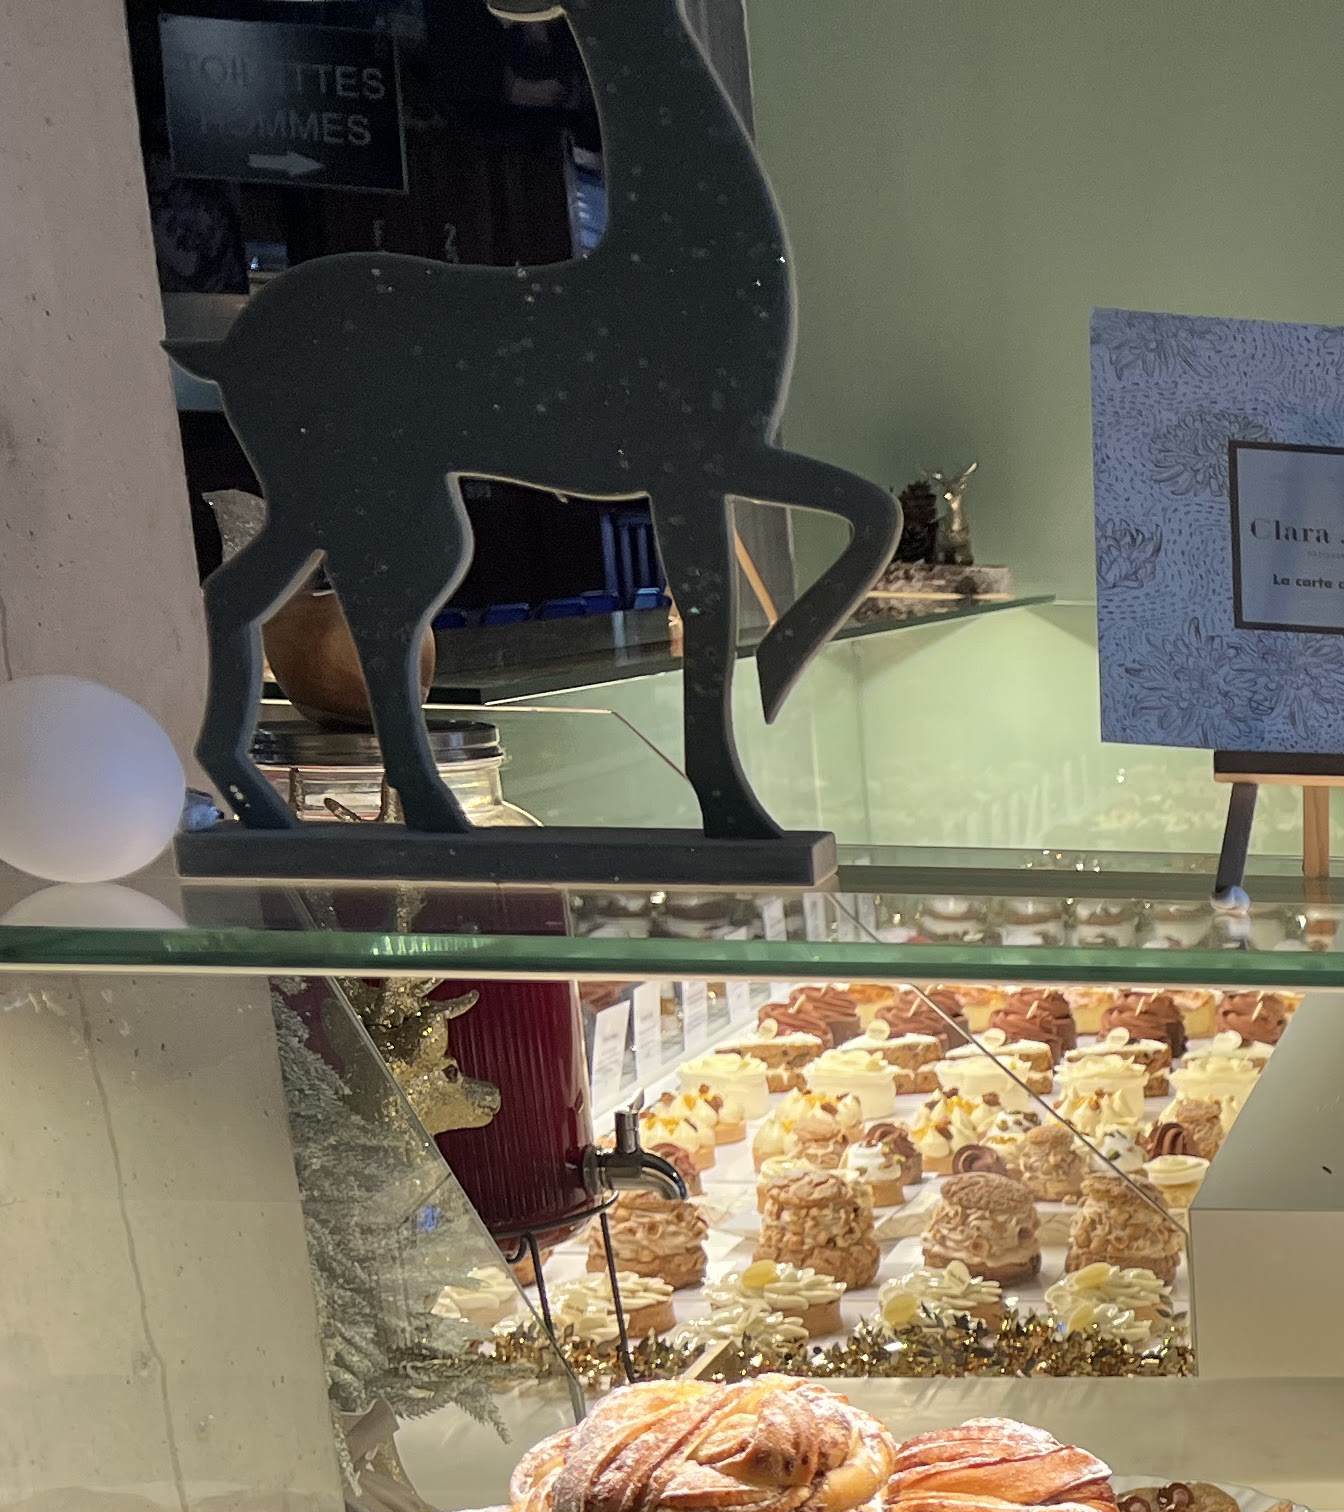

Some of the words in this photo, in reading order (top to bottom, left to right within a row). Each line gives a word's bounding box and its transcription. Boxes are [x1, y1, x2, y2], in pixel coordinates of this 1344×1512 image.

[1250, 518, 1329, 544] Clara
[1273, 574, 1290, 585] La
[1295, 576, 1333, 589] carte
